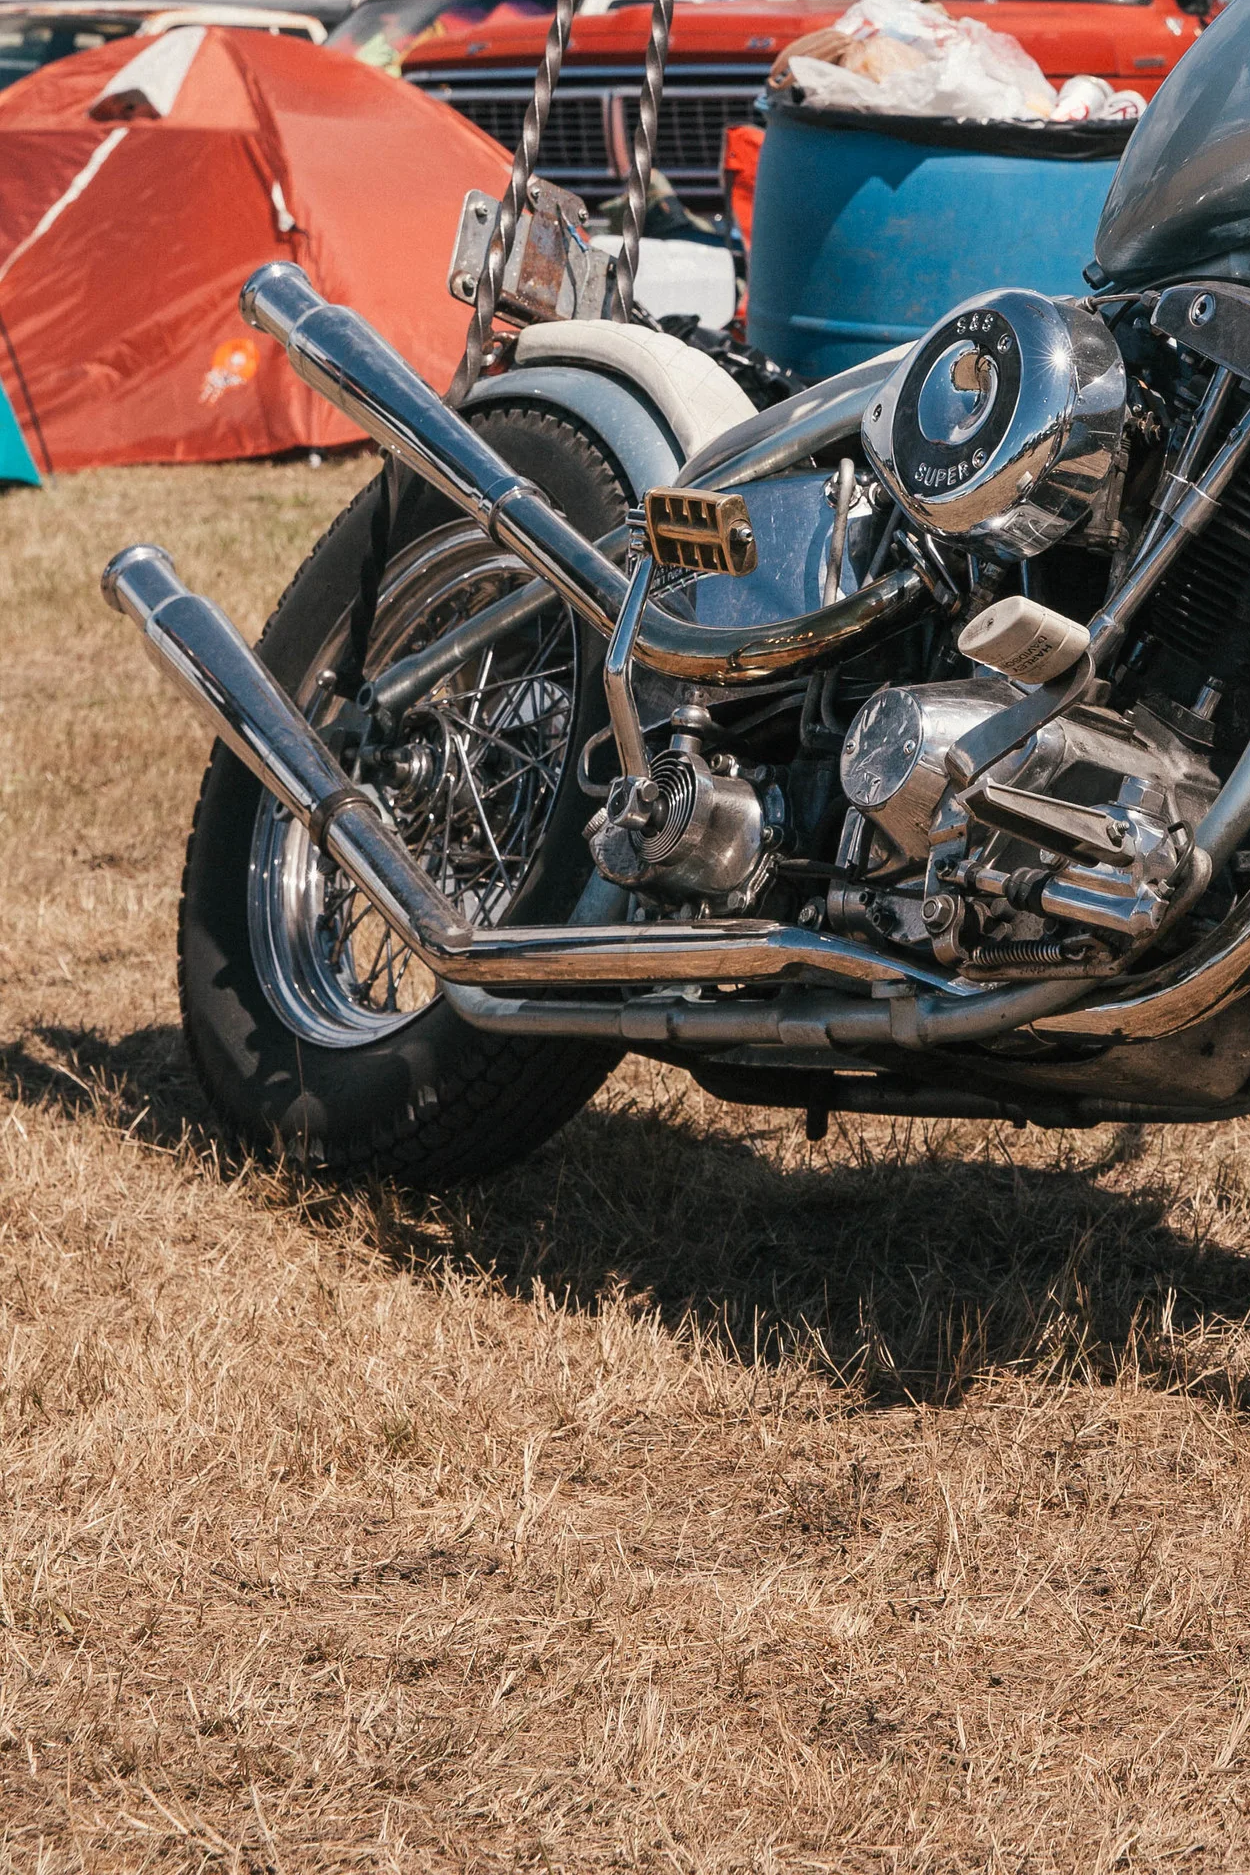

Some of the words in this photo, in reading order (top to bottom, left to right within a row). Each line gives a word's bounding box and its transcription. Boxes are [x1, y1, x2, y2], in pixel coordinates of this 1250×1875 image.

[956, 313, 994, 334] S&S
[914, 461, 970, 488] SUPER
[1013, 644, 1053, 673] HARLEY
